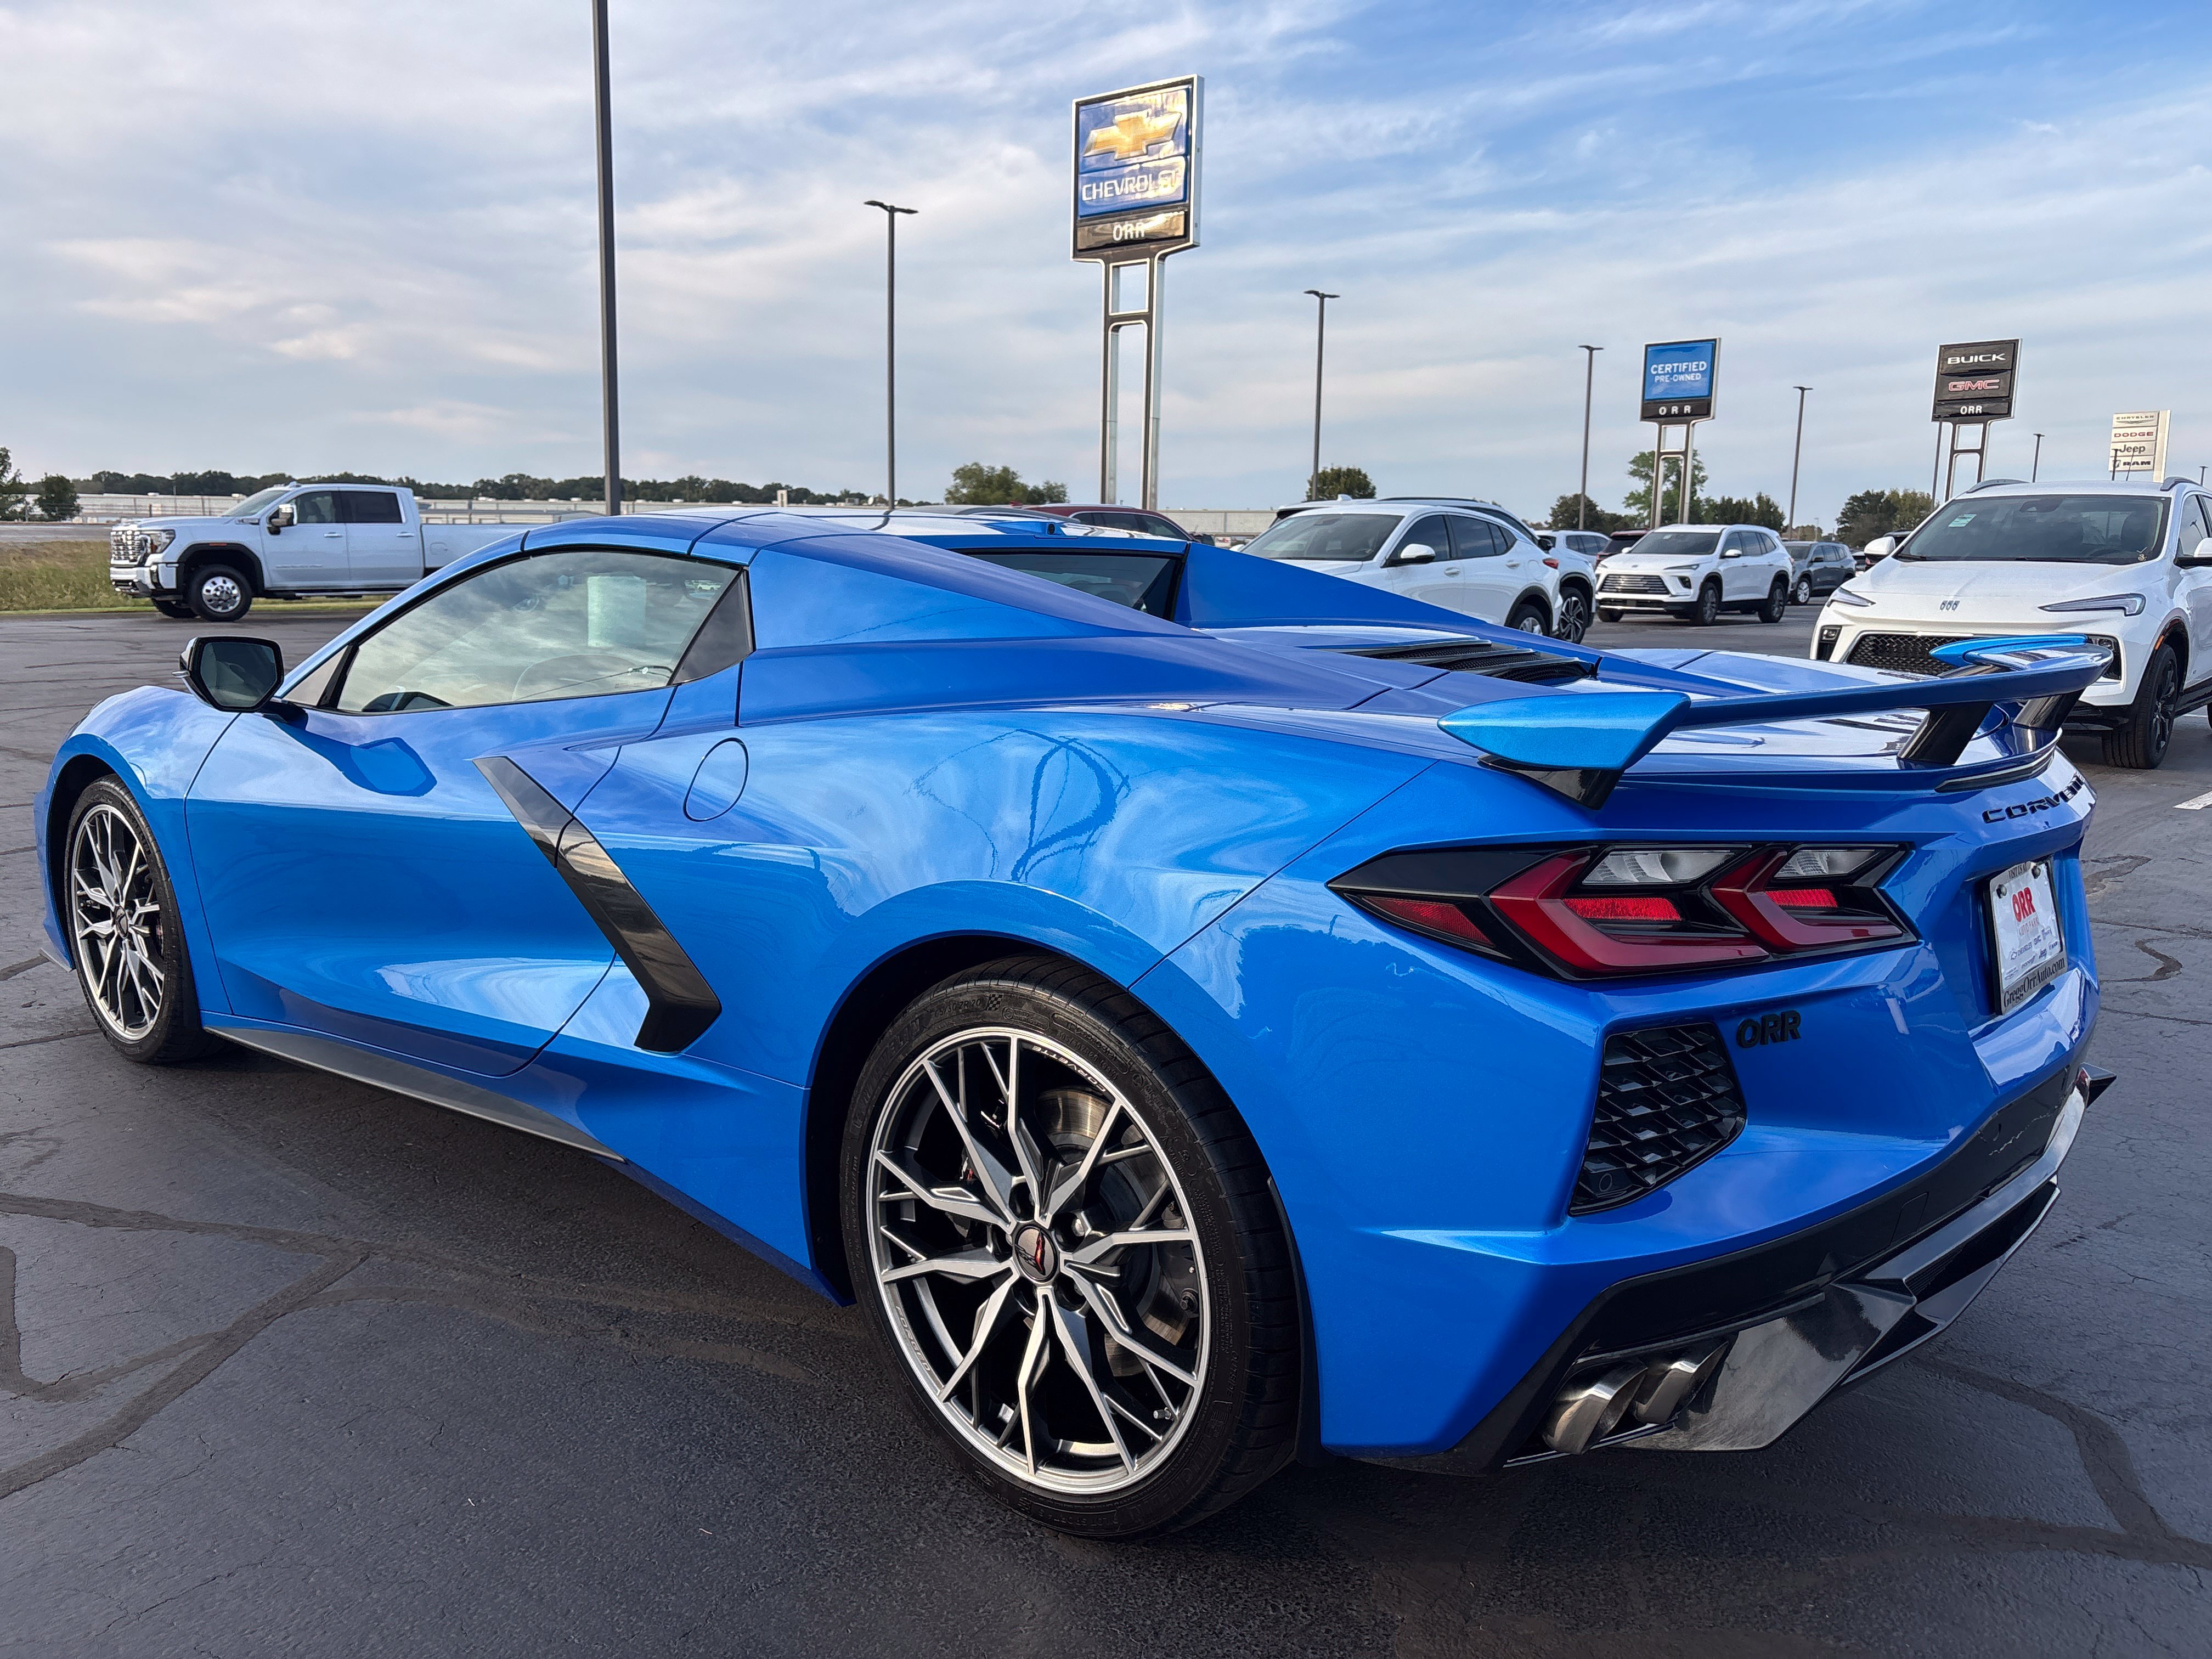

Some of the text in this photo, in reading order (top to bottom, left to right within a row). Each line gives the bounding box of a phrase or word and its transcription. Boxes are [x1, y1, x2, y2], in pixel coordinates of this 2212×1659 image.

[1081, 170, 1180, 201] CHEVROLET
[1113, 222, 1145, 241] ORR
[1948, 353, 2006, 365] BUICK
[1650, 361, 1707, 375] CERTIFIED
[1654, 373, 1702, 383] PRE-OWNED
[1948, 379, 2000, 392] GMC
[1658, 405, 1691, 415] ORR
[1960, 405, 1983, 415] ORR
[2119, 444, 2146, 454] Jeep
[2012, 887, 2036, 922] ORR
[2004, 957, 2065, 1008] GreggOrrAuto.com
[1736, 1009, 1801, 1048] ORR
[1031, 1045, 1106, 1092] CORVETTE
[895, 1306, 931, 1370] FORGED
